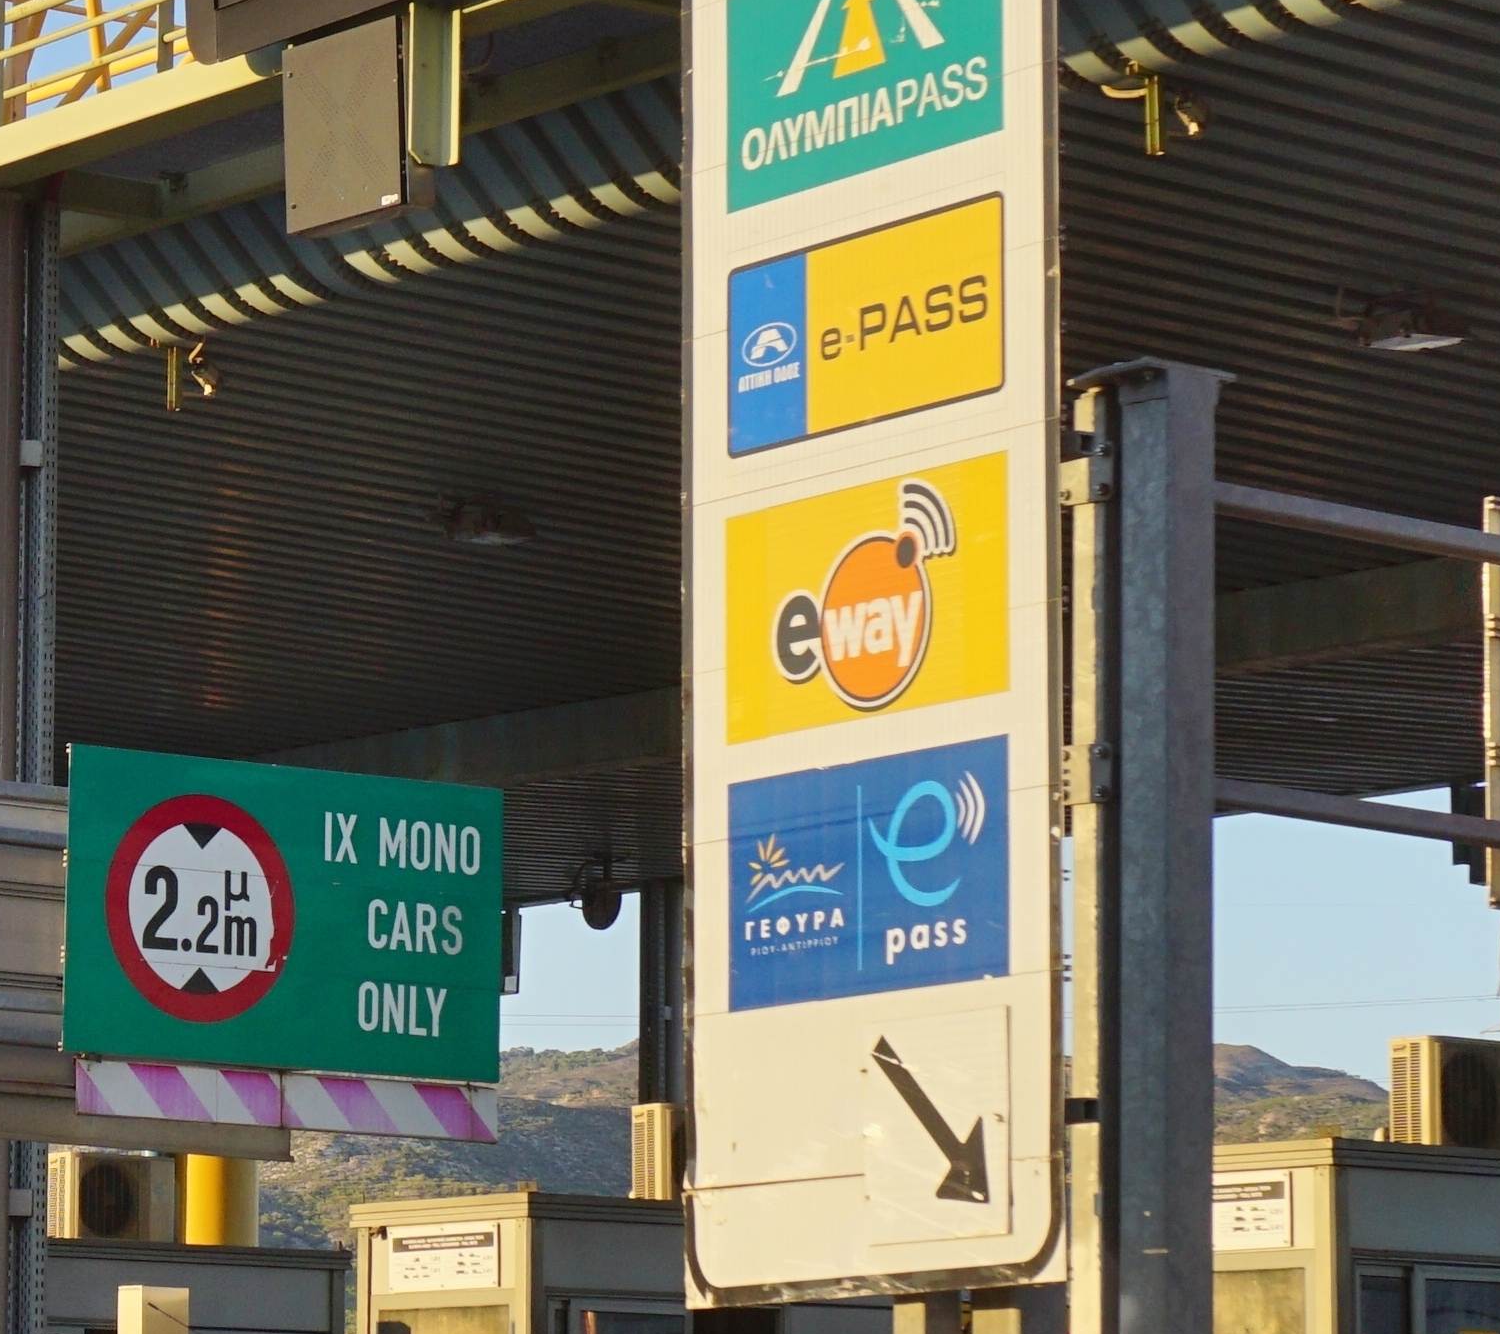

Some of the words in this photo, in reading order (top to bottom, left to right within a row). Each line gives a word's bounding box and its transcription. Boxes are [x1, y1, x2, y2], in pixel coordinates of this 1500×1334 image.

[820, 274, 989, 361] e-PASS
[777, 589, 923, 675] eway
[367, 898, 463, 957] CARS
[744, 907, 845, 941] ΓΕΦΥΡΑ
[885, 918, 968, 965] pass
[357, 981, 448, 1038] ONLY
